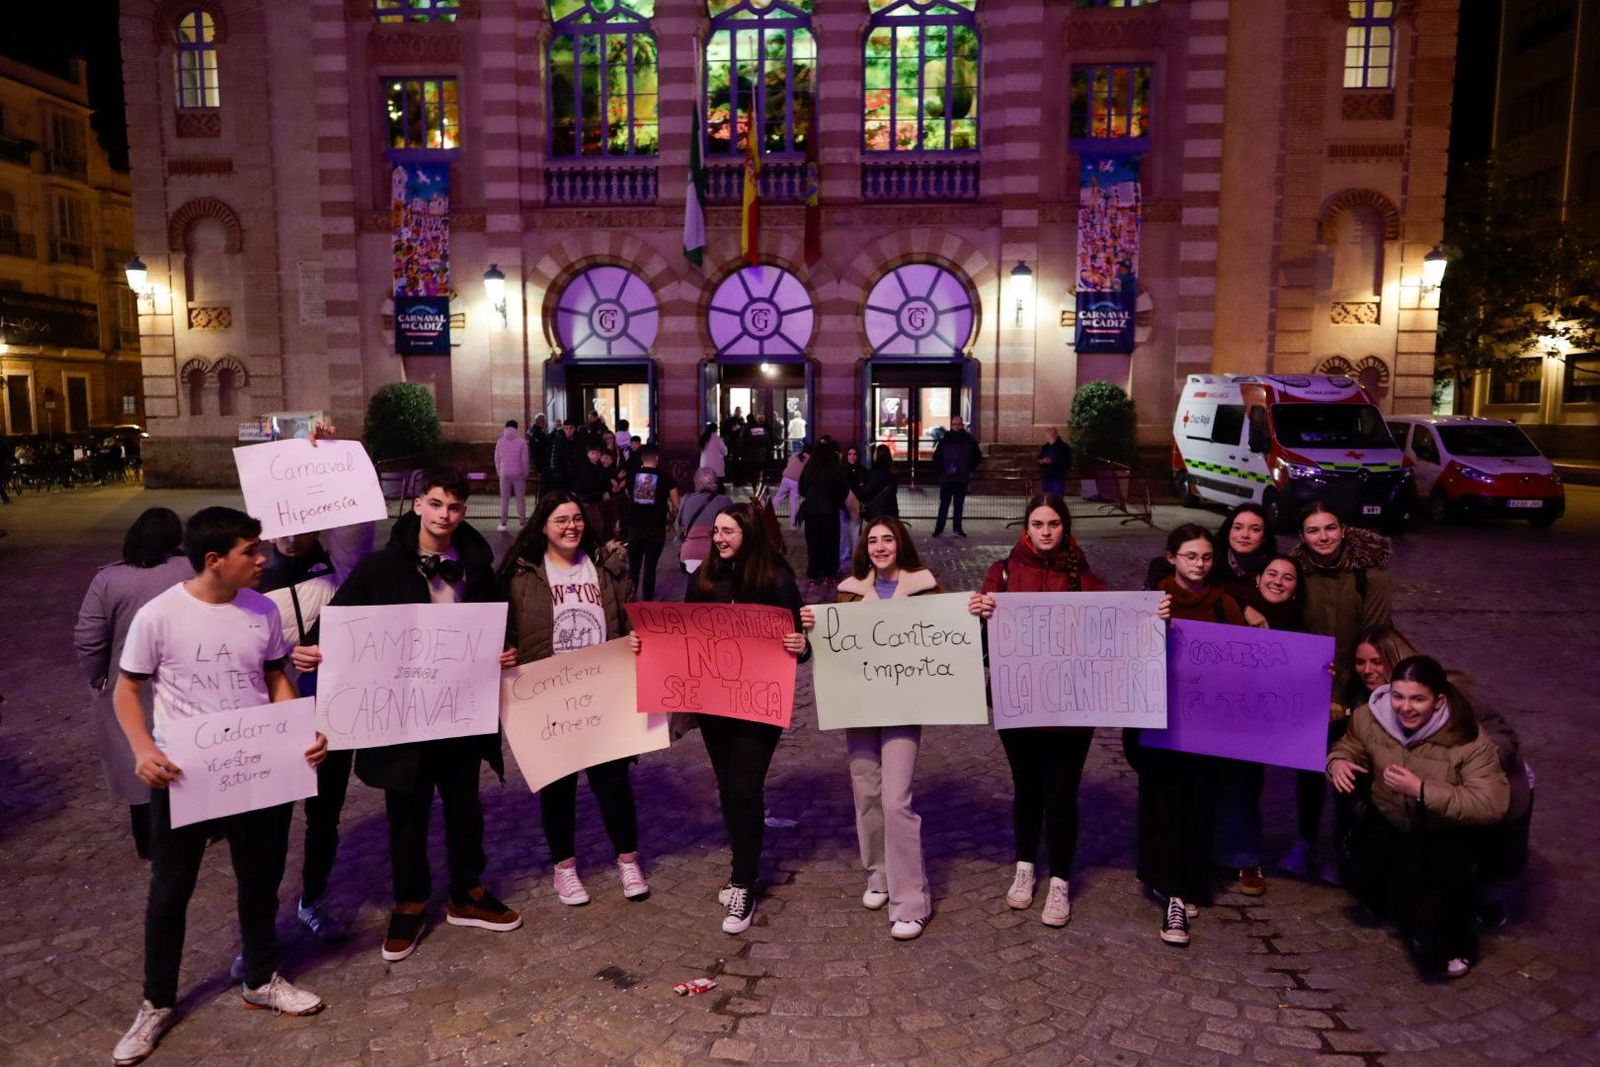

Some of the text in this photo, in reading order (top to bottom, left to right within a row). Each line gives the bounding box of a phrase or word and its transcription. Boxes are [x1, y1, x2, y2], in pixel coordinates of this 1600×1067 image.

[397, 314, 447, 323] CARNAVAL
[1078, 311, 1131, 319] CARNAVAL
[269, 451, 356, 481] Carnaval
[572, 582, 605, 608] YOR
[639, 607, 796, 640] LA CANTERA
[872, 620, 972, 648] Cantera
[996, 605, 1167, 658] DEFENDAMOS
[195, 642, 233, 662] LA
[684, 636, 744, 681] NO
[511, 664, 602, 701] Cantera
[862, 656, 955, 686] importa
[563, 693, 593, 712] no
[660, 675, 782, 719] SE TOCA
[998, 658, 1167, 718] LA CANTERA
[326, 685, 474, 736] CARNAVAL
[194, 717, 272, 750] Cuidar
[540, 713, 604, 742] dinero
